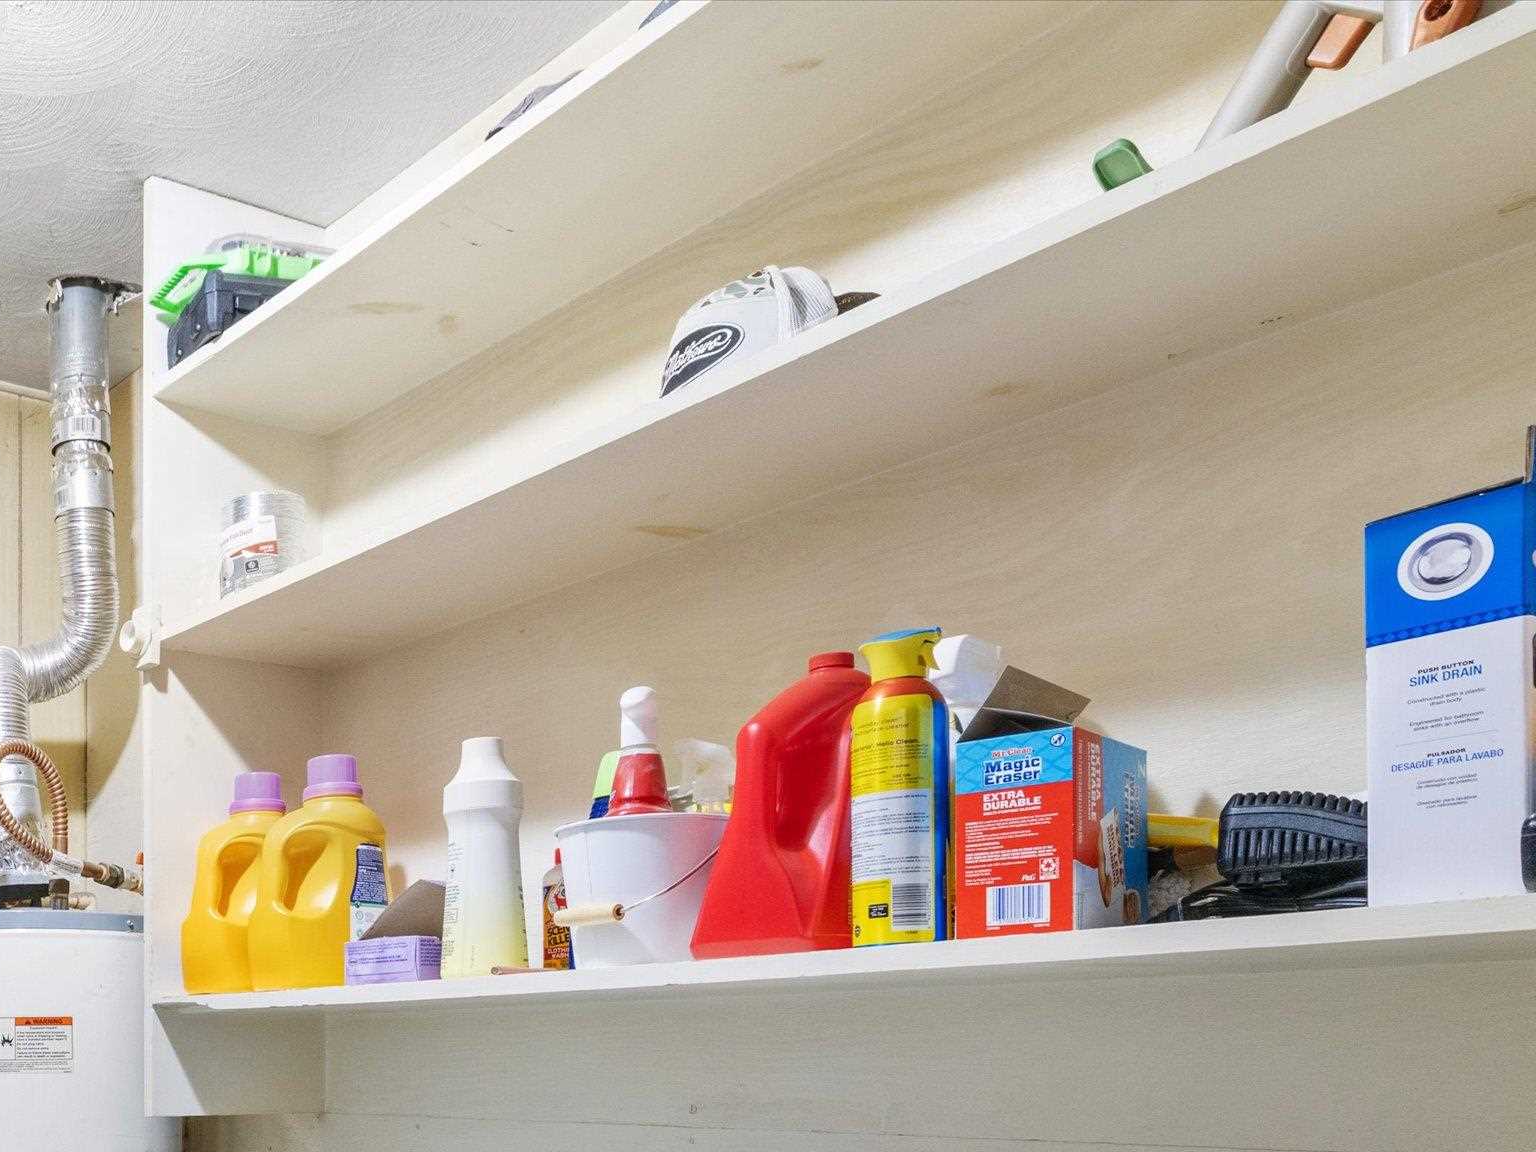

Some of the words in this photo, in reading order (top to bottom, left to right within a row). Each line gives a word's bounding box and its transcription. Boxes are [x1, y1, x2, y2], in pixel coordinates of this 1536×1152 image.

[1417, 667, 1440, 675] PUSH
[1440, 659, 1475, 671] BUTTON
[1409, 673, 1439, 687] SINK
[1441, 664, 1483, 681] DRAIN
[1427, 748, 1466, 758] PULSADOR
[1437, 754, 1463, 766] PARA
[1465, 748, 1504, 762] LAVABO
[984, 757, 1041, 774] Magic
[984, 770, 1041, 786] Eraser
[983, 790, 1025, 802] EXTRA
[983, 796, 1042, 812] DURABLE
[547, 925, 571, 936] SCEN
[547, 932, 571, 946] KILLE
[32, 1017, 64, 1026] WARNING
